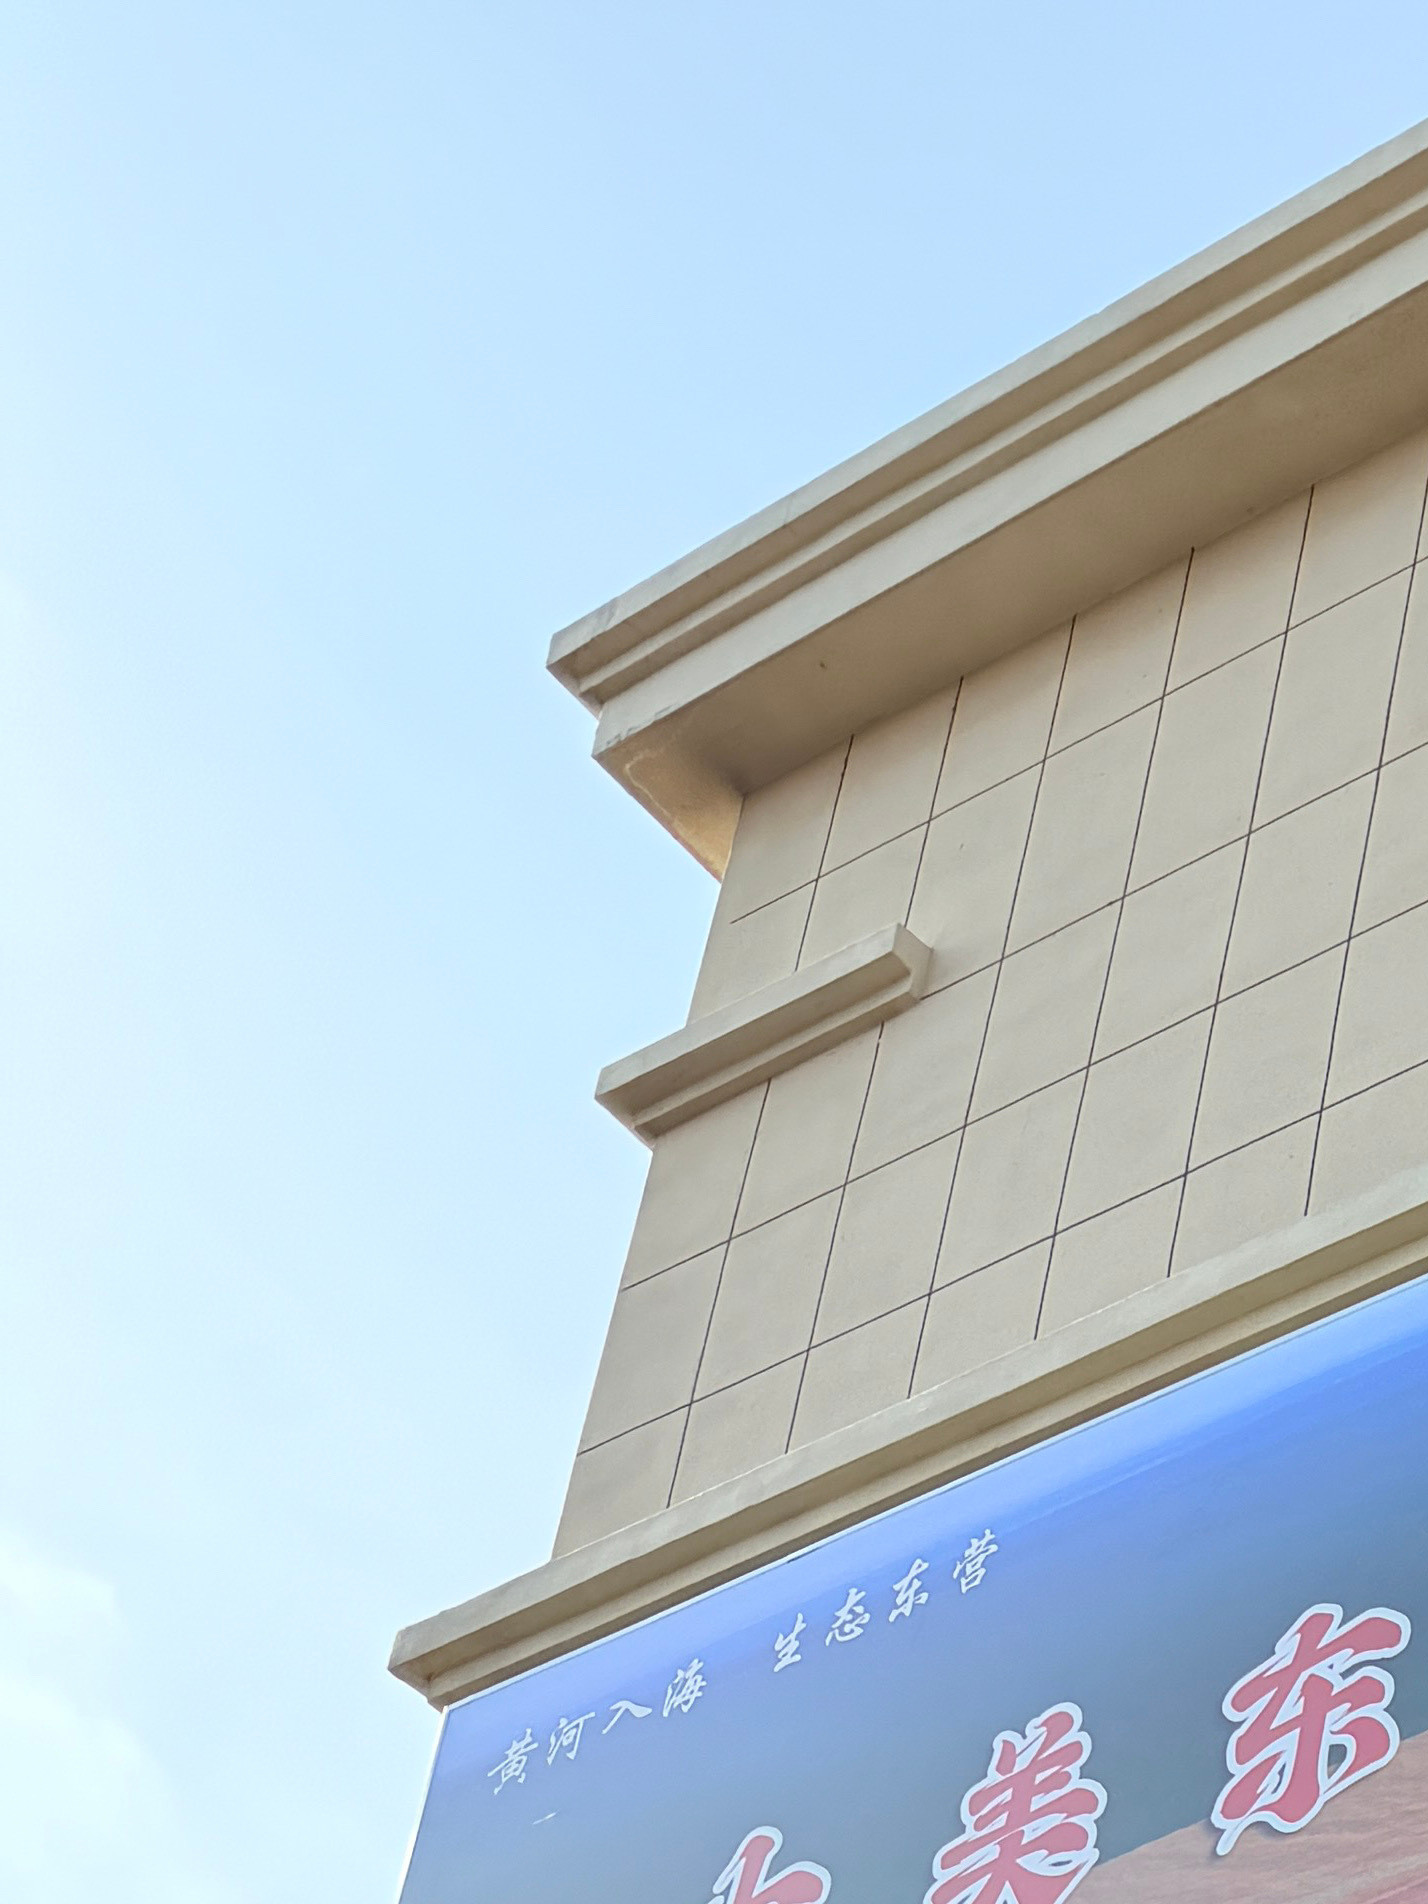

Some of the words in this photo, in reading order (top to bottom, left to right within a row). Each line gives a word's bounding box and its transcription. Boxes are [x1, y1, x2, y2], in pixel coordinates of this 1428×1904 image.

[487, 1659, 708, 1795] 黄河入海
[773, 1529, 1000, 1673] 生态东营
